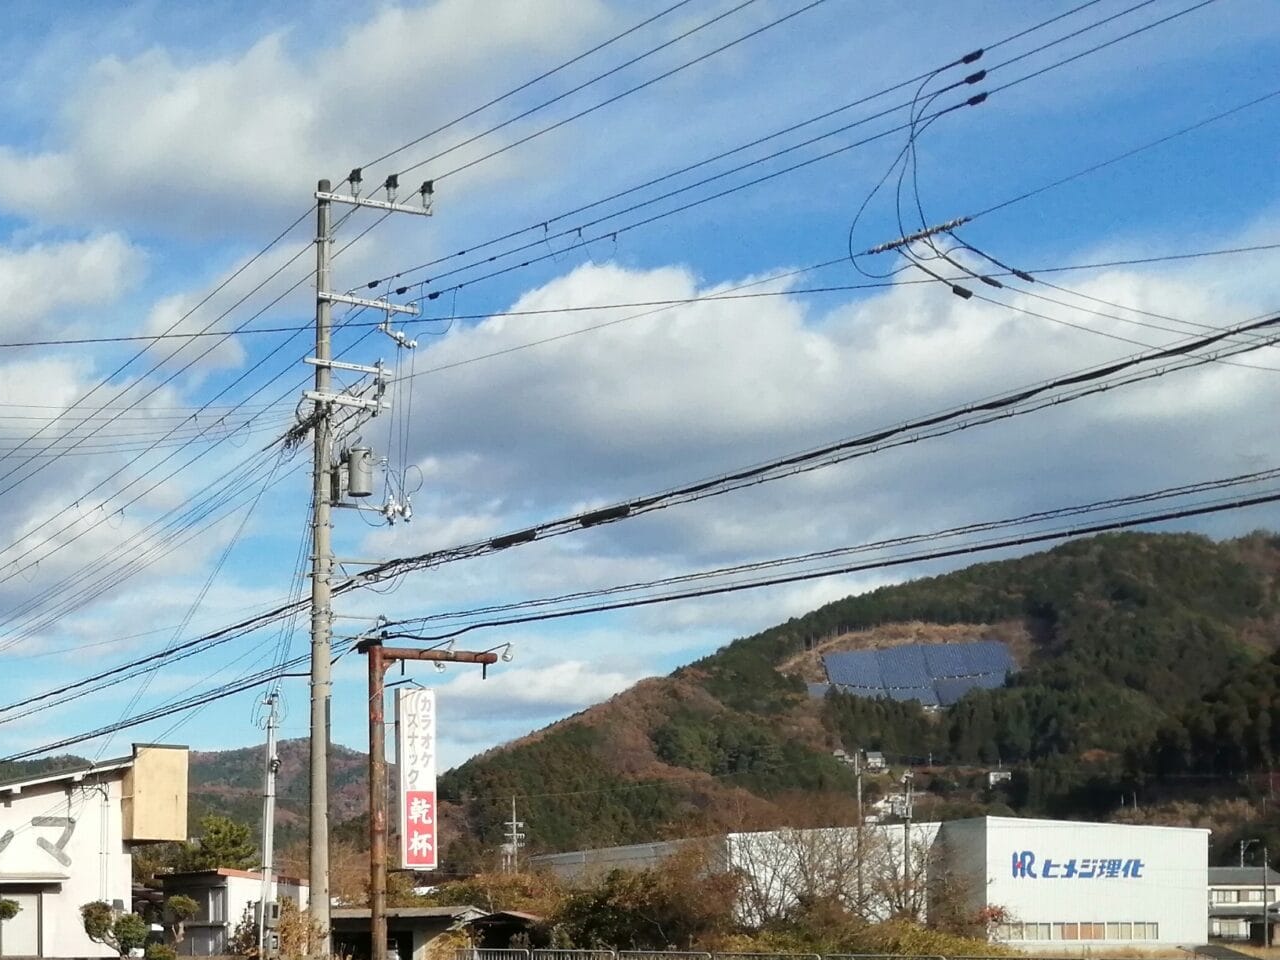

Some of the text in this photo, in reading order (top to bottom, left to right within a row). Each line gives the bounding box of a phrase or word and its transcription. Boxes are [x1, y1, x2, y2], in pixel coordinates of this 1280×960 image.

[407, 713, 419, 785] スナック
[420, 696, 433, 768] カラオケ
[407, 797, 433, 857] 乾杯
[1042, 858, 1145, 878] ヒメジ理化
